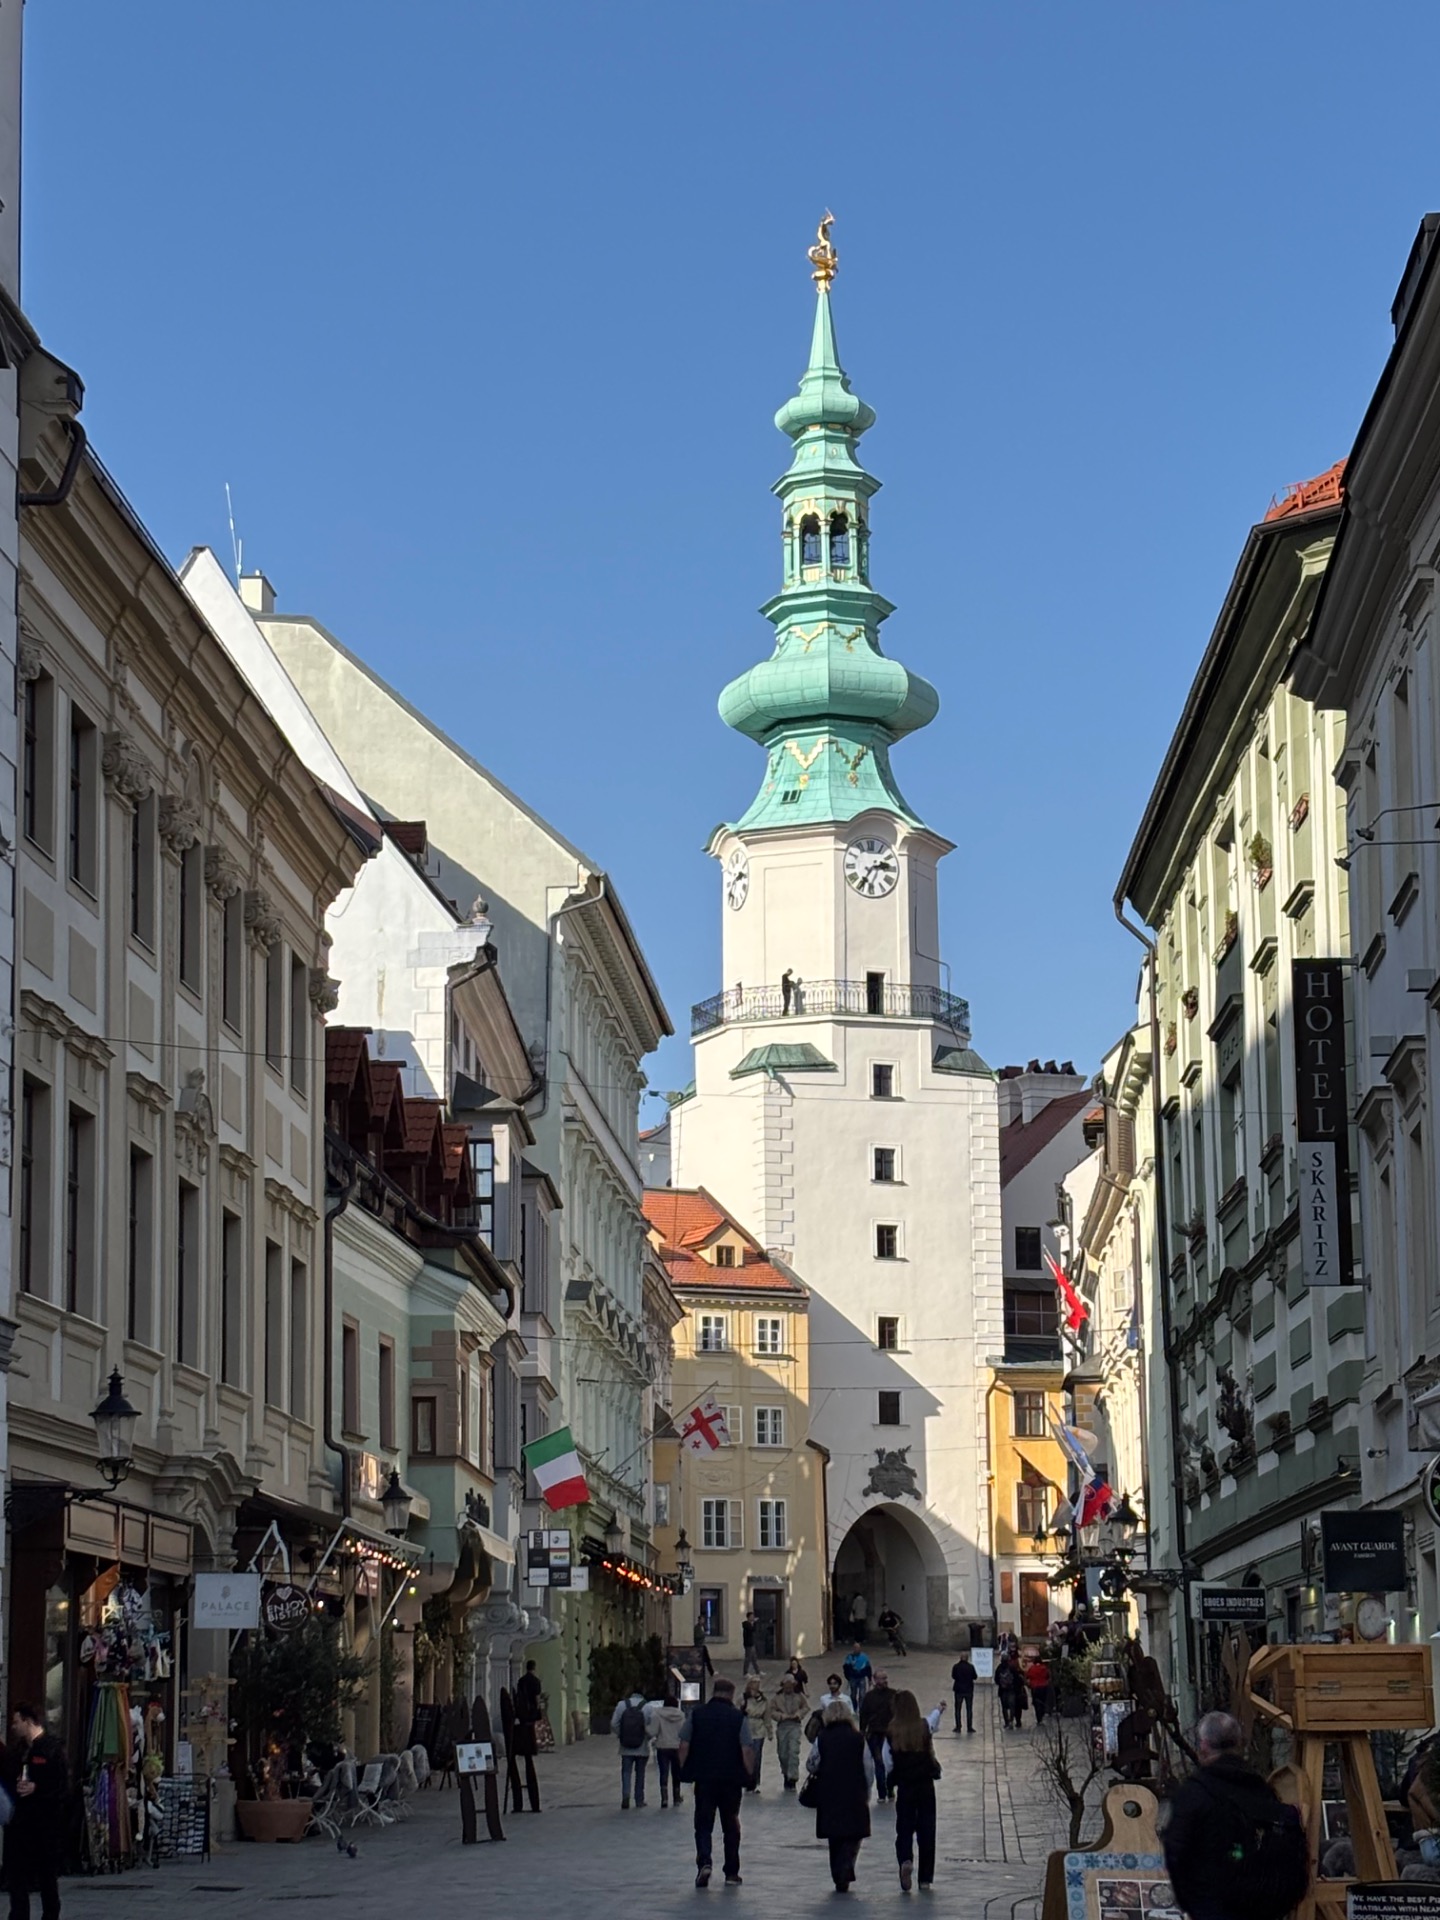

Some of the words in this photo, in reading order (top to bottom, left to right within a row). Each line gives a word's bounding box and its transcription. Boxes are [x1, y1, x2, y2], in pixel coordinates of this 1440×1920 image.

[1304, 972, 1336, 1134] HOTEL
[1310, 1150, 1330, 1277] SKARITZ
[1330, 1542, 1359, 1551] AVANT
[1360, 1541, 1398, 1551] GUARDE
[201, 1601, 251, 1611] PALACE
[266, 1598, 307, 1614] ENJOY
[1226, 1597, 1265, 1607] INDUSTRIES
[1352, 1894, 1364, 1902] WE
[1389, 1895, 1405, 1903] THE
[1407, 1896, 1427, 1904] BEST
[1352, 1904, 1397, 1912] BRATISLAVA
[1398, 1905, 1418, 1913] WITH
